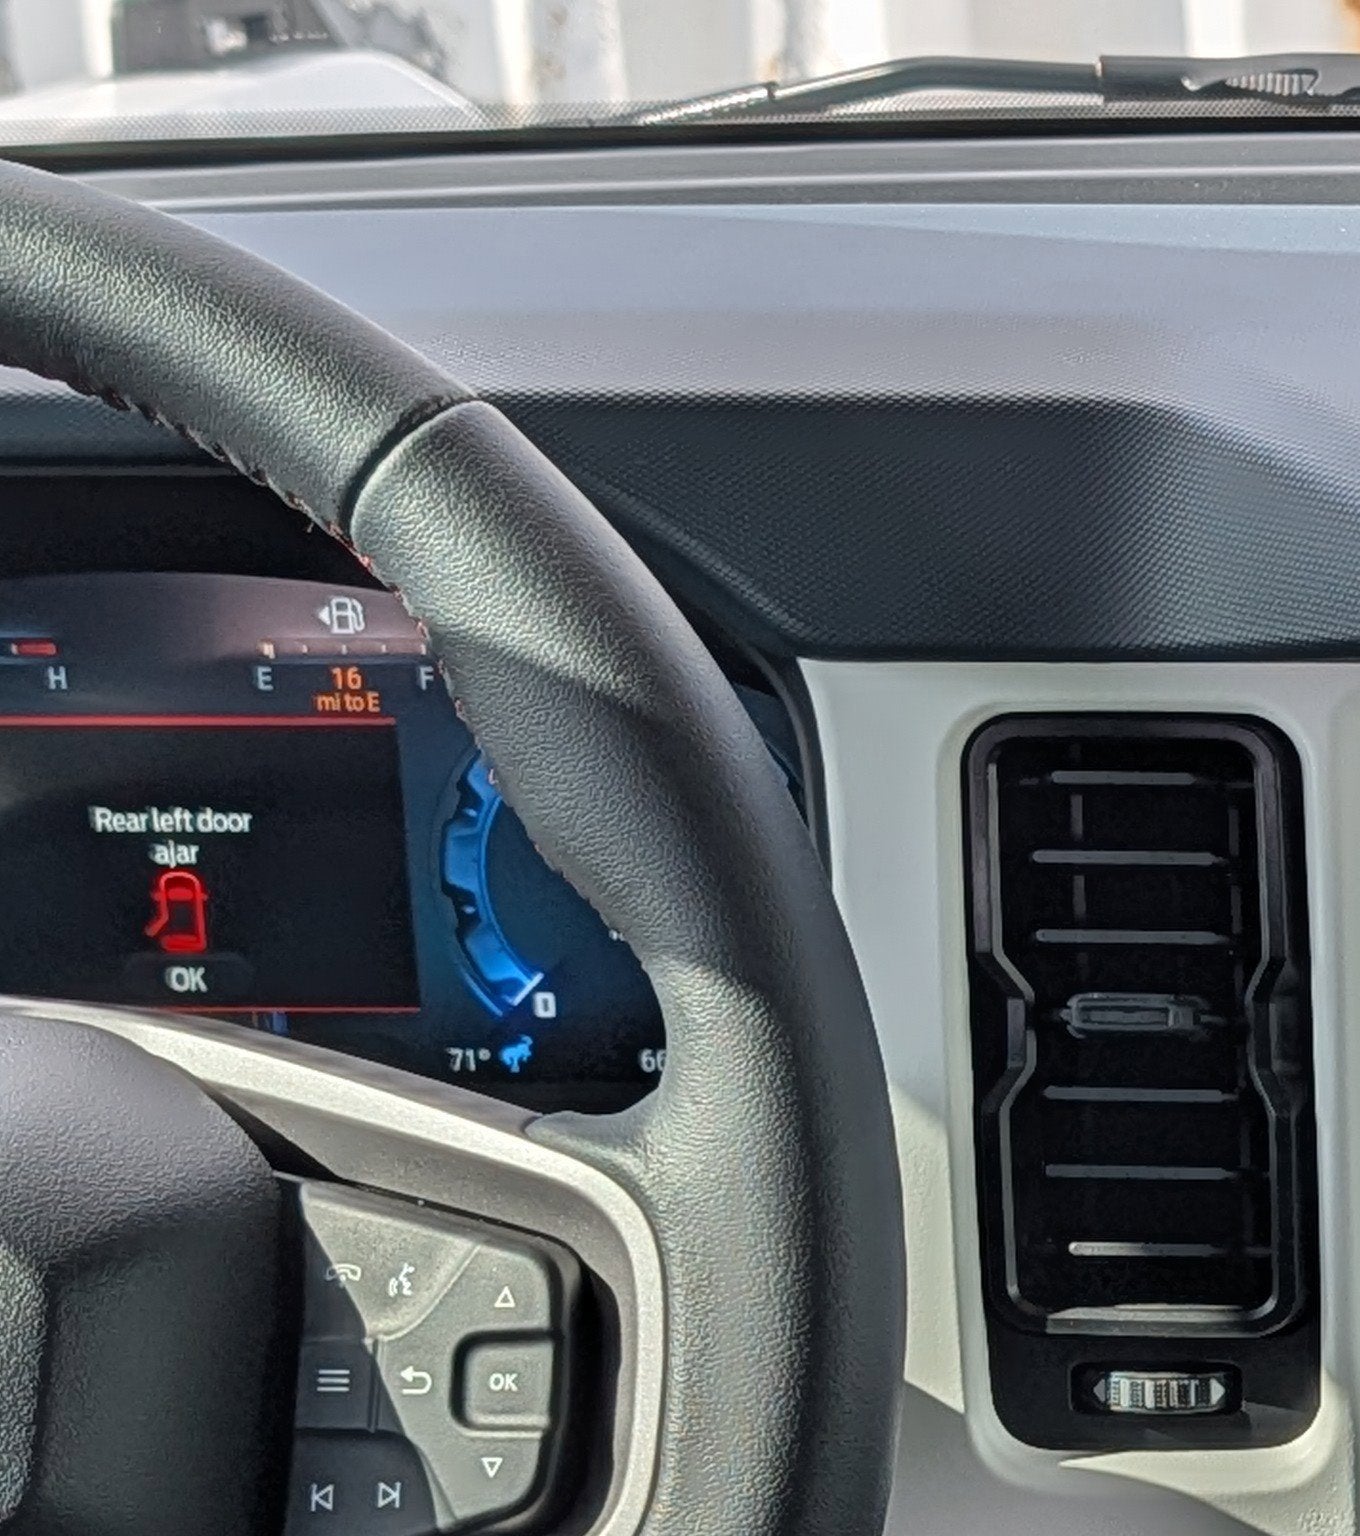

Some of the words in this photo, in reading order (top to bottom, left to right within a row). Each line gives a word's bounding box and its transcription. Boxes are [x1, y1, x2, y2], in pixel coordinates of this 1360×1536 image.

[47, 666, 68, 691] H
[255, 666, 275, 691] E
[331, 666, 362, 690] 16
[420, 666, 434, 691] F
[344, 692, 366, 713] to
[367, 692, 380, 713] E
[91, 806, 149, 833] Rear
[150, 806, 195, 833] left
[196, 806, 253, 833] door
[151, 840, 200, 868] ajar
[167, 966, 208, 992] OK
[489, 1372, 520, 1392] OK
